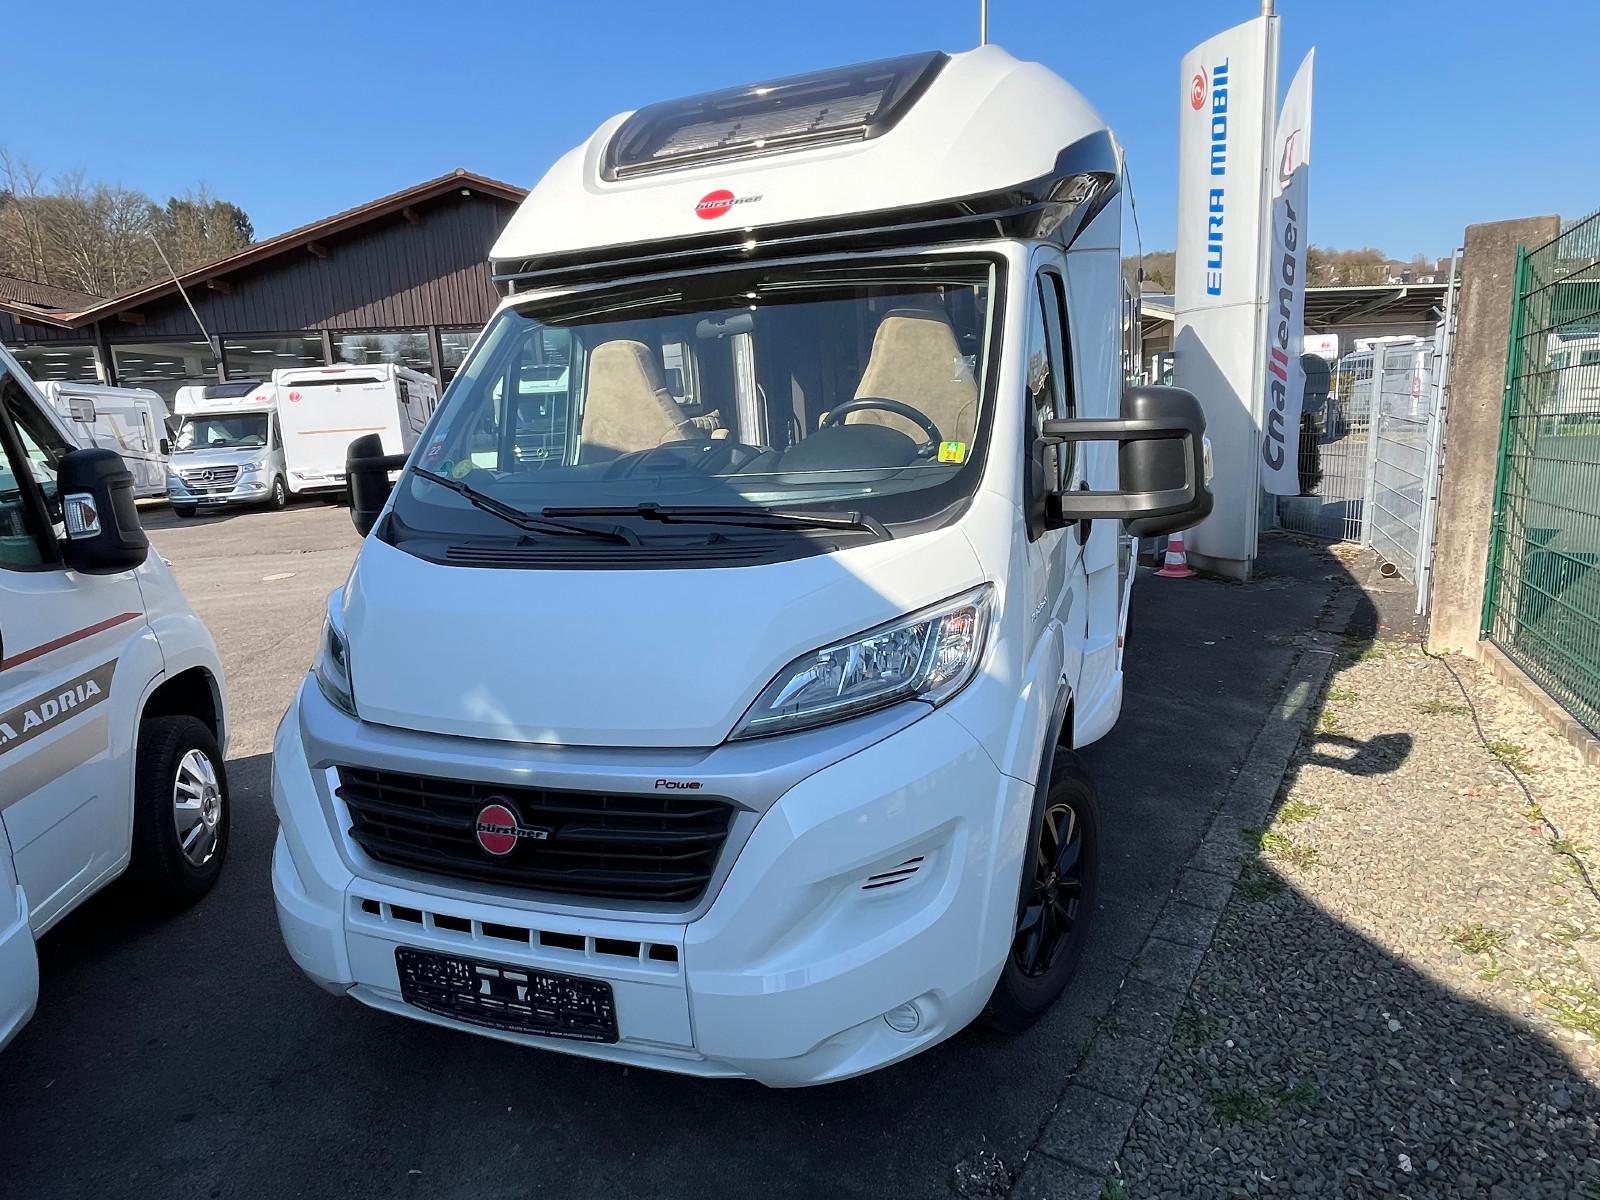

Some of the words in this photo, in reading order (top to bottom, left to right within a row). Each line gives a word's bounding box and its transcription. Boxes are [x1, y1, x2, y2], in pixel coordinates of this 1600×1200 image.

[1210, 57, 1229, 176] MOBIL
[1206, 188, 1226, 297] EURA
[23, 679, 102, 733] ADRIA
[477, 823, 543, 838] bürstner
